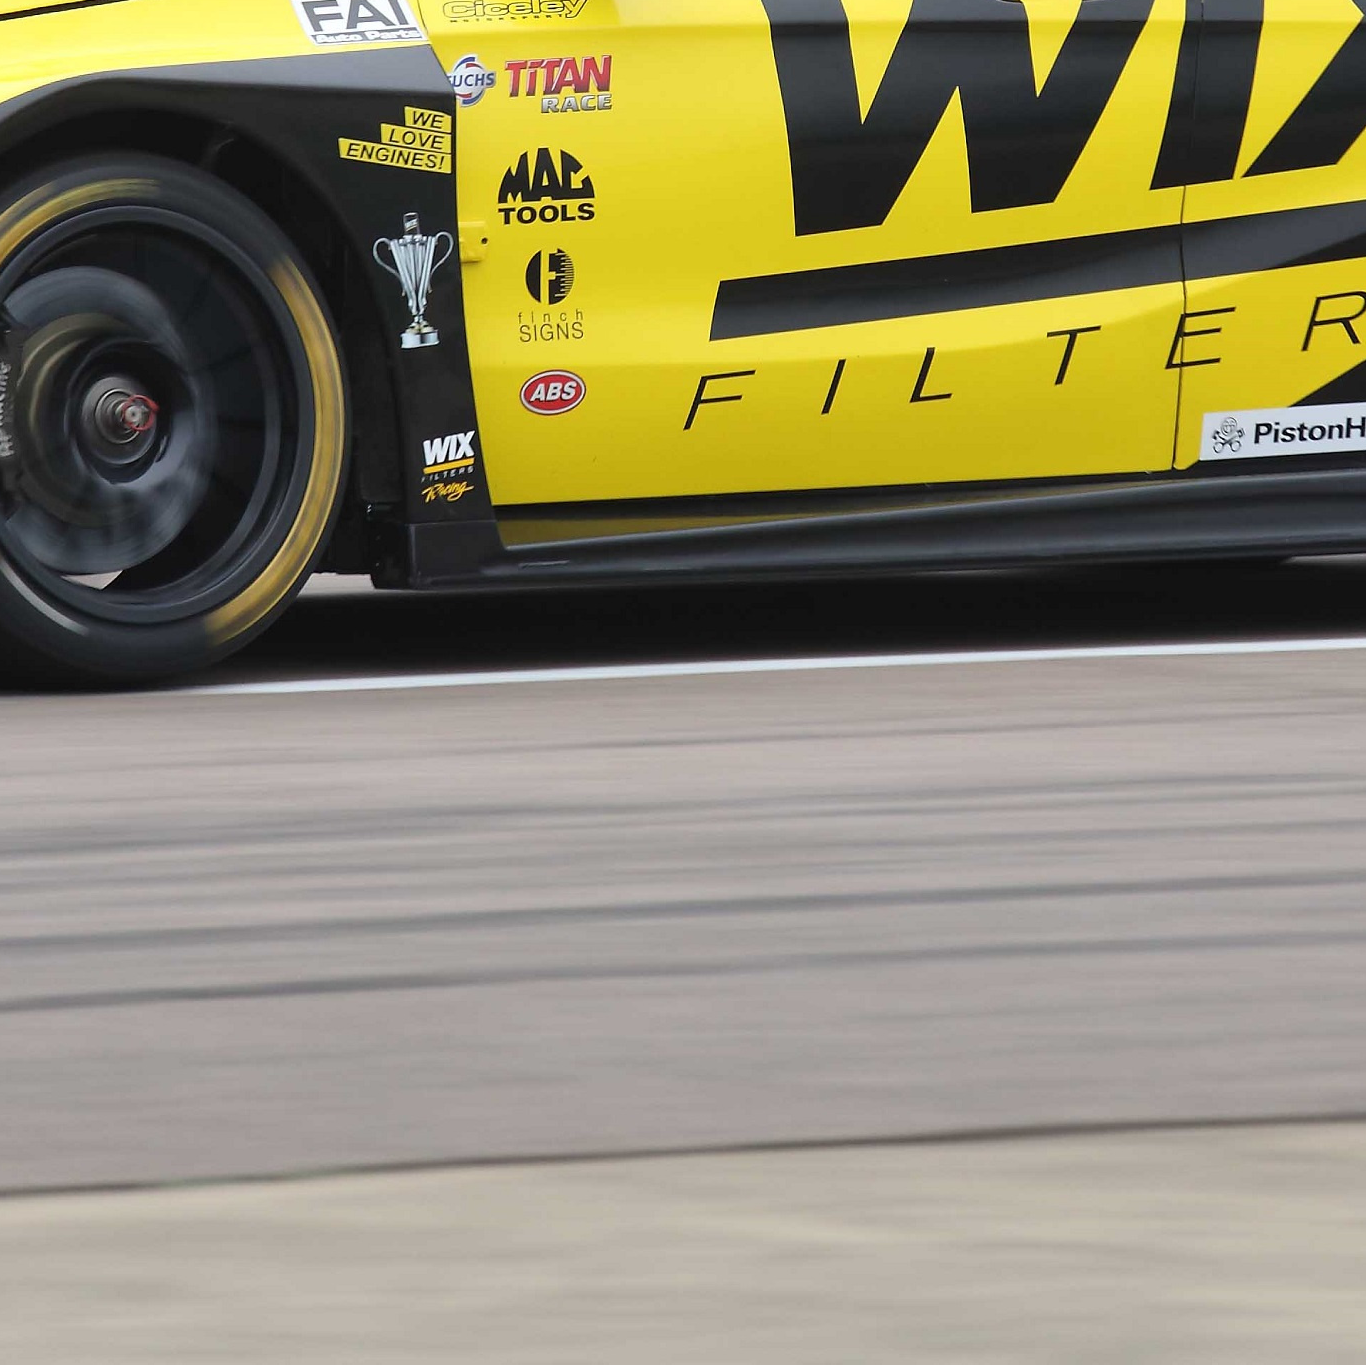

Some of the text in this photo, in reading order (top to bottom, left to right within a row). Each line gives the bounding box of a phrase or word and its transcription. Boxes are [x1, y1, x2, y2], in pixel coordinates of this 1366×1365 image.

[315, 30, 422, 44] Auto Parts
[541, 94, 613, 114] RACE
[413, 110, 445, 130] WE
[388, 128, 445, 151] LOVE
[346, 142, 445, 171] ENGINES!
[497, 147, 596, 204] MAC
[497, 202, 596, 226] TOOLS
[517, 308, 584, 324] finch
[519, 321, 585, 343] SIGNS
[528, 380, 578, 402] ABS
[422, 430, 476, 466] WIX
